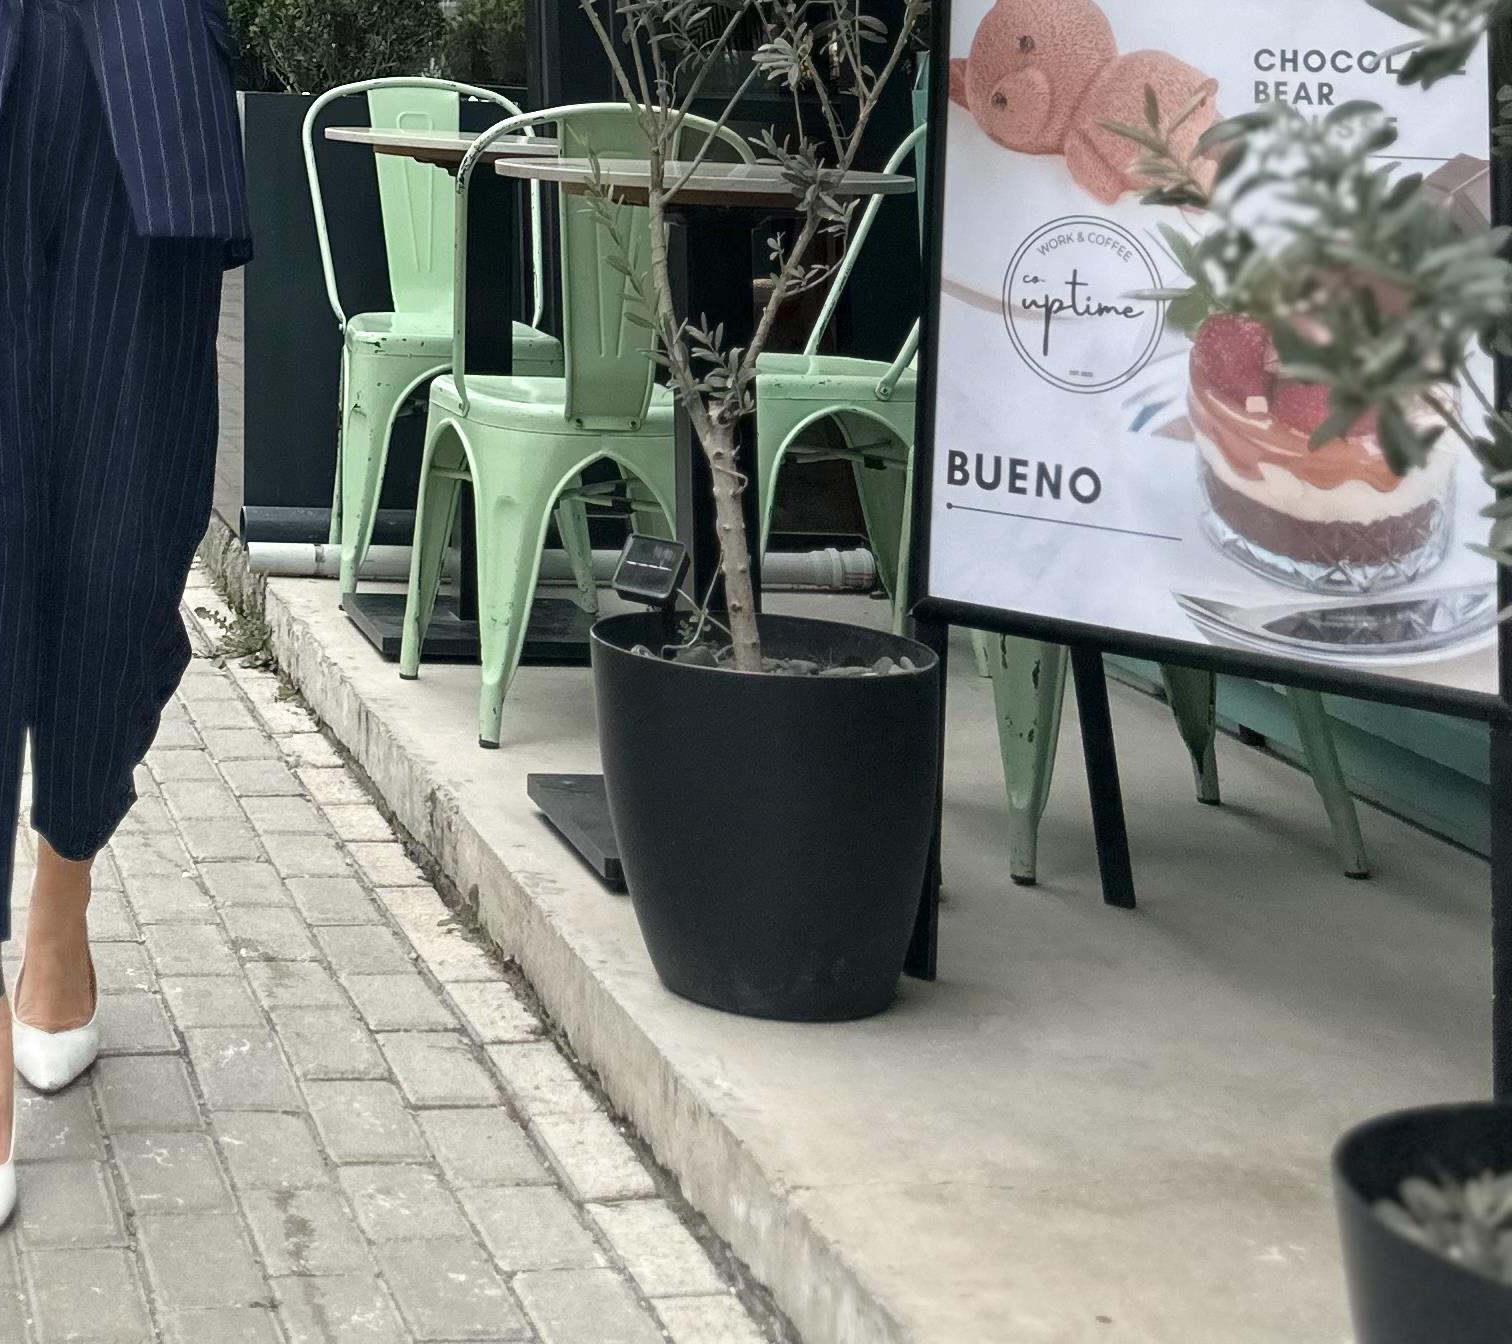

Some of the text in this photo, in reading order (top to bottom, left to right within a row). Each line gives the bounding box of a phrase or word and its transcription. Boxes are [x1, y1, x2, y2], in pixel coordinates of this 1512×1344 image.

[1254, 80, 1335, 105] BEAR
[1037, 231, 1133, 263] WORK & COFFEE
[1021, 269, 1144, 356] uptime
[947, 449, 1102, 504] BUENO
